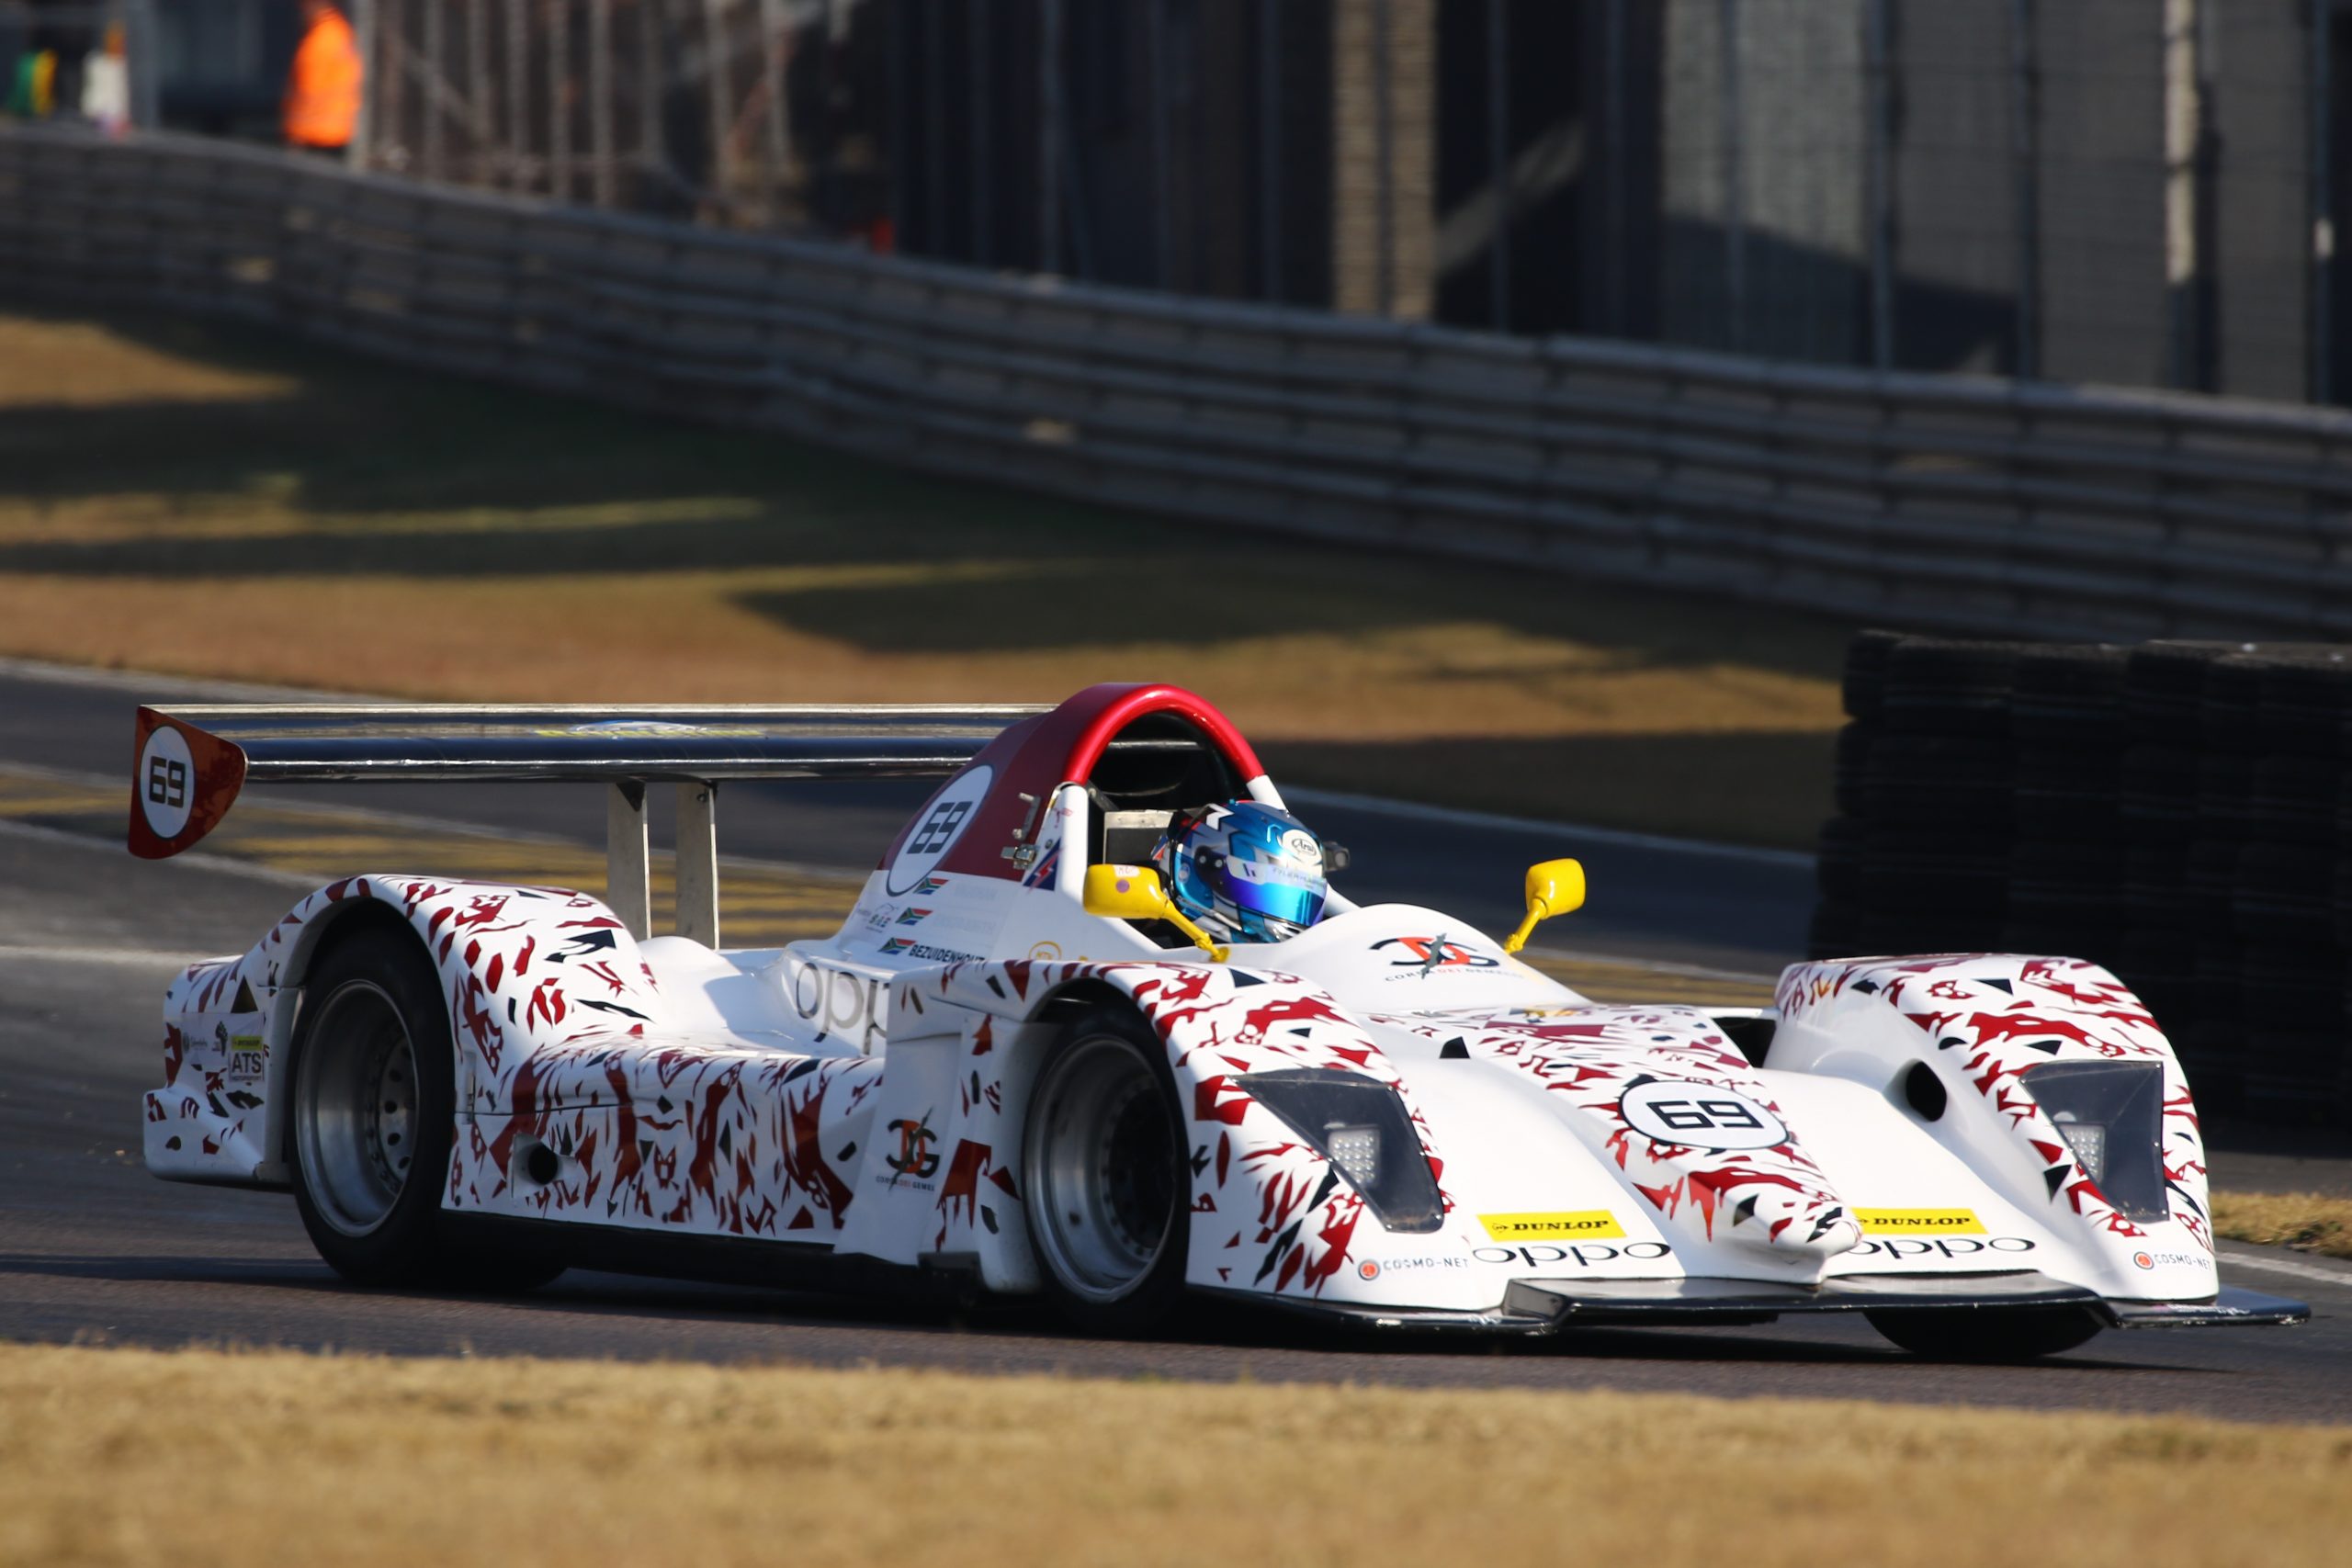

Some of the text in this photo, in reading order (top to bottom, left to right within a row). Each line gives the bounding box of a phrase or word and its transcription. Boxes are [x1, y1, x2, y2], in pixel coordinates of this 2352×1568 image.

[149, 756, 186, 808] 69
[906, 801, 974, 854] 69
[797, 962, 889, 1055] opp
[232, 1052, 262, 1074] ATS
[1645, 1100, 1765, 1130] 69
[1513, 1219, 1609, 1232] DUNLOP
[1873, 1217, 1971, 1225] DUNLOP
[1472, 1242, 1671, 1268] oppo
[1847, 1237, 2036, 1259] oppo
[1383, 1257, 1469, 1271] COSMO-NET
[2154, 1254, 2212, 1272] COSMO-NET
